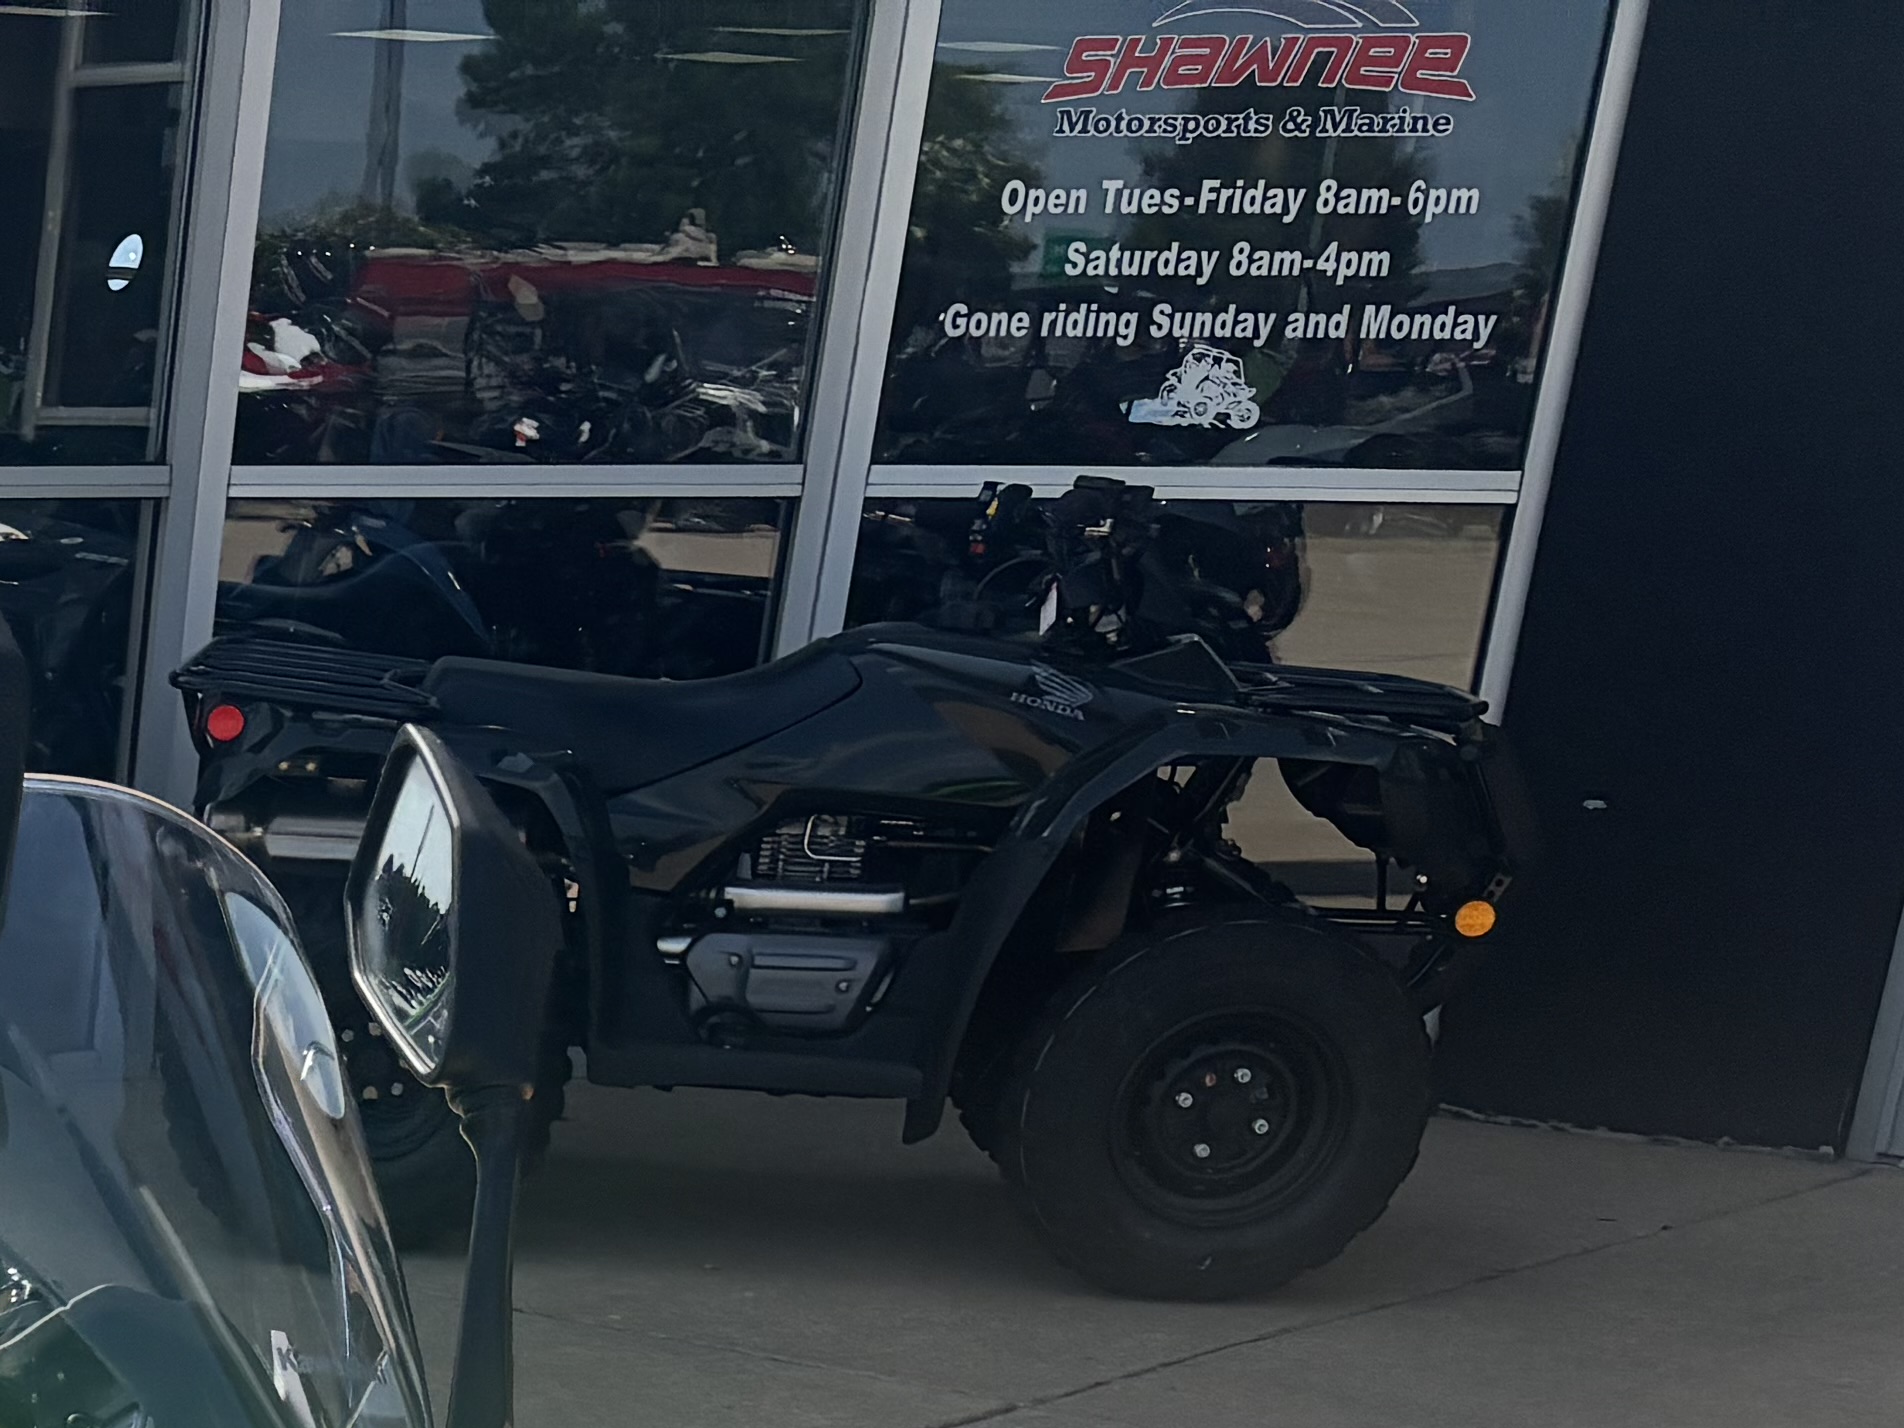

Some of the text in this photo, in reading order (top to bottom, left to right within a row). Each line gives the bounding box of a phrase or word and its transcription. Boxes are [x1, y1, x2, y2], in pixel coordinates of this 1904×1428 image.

[1053, 106, 1453, 144] Motorsports & Marine
[1000, 179, 1088, 223] Open
[1064, 241, 1391, 285] Saturday 8am-4pm
[944, 303, 1498, 349] Gone riding Sunday and Monday
[1010, 692, 1085, 721] HONDA
